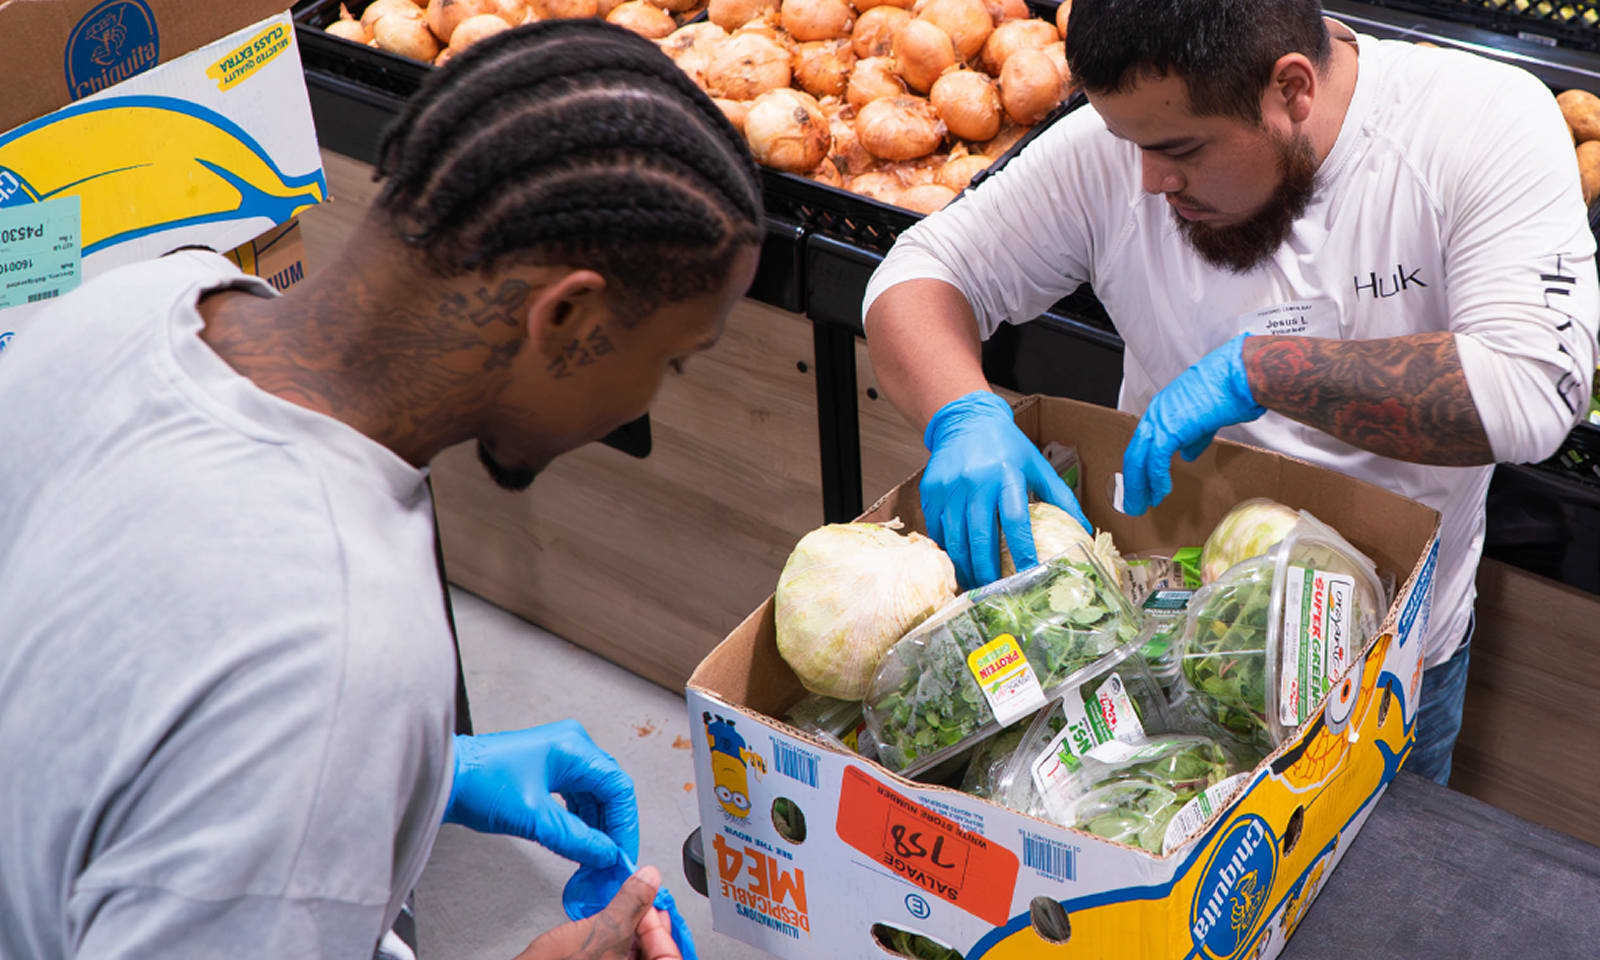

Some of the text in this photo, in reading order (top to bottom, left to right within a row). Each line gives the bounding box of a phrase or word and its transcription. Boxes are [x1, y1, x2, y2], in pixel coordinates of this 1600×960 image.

[76, 43, 156, 98] Chiquita
[219, 26, 283, 73] CLASS EXTRA
[224, 37, 288, 84] SELECTED QUALITY
[0, 223, 44, 243] P4530
[267, 260, 304, 291] IUM
[979, 649, 1020, 680] PROTEIN
[1068, 720, 1093, 755] NS!
[875, 785, 988, 849] WRITE STORE NUMBER
[724, 825, 793, 860] SEE THE MOVIE
[891, 824, 955, 869] 758
[883, 851, 959, 901] SALVAGE
[1193, 818, 1267, 941] Chiquita
[720, 879, 811, 934] DESPICABLE
